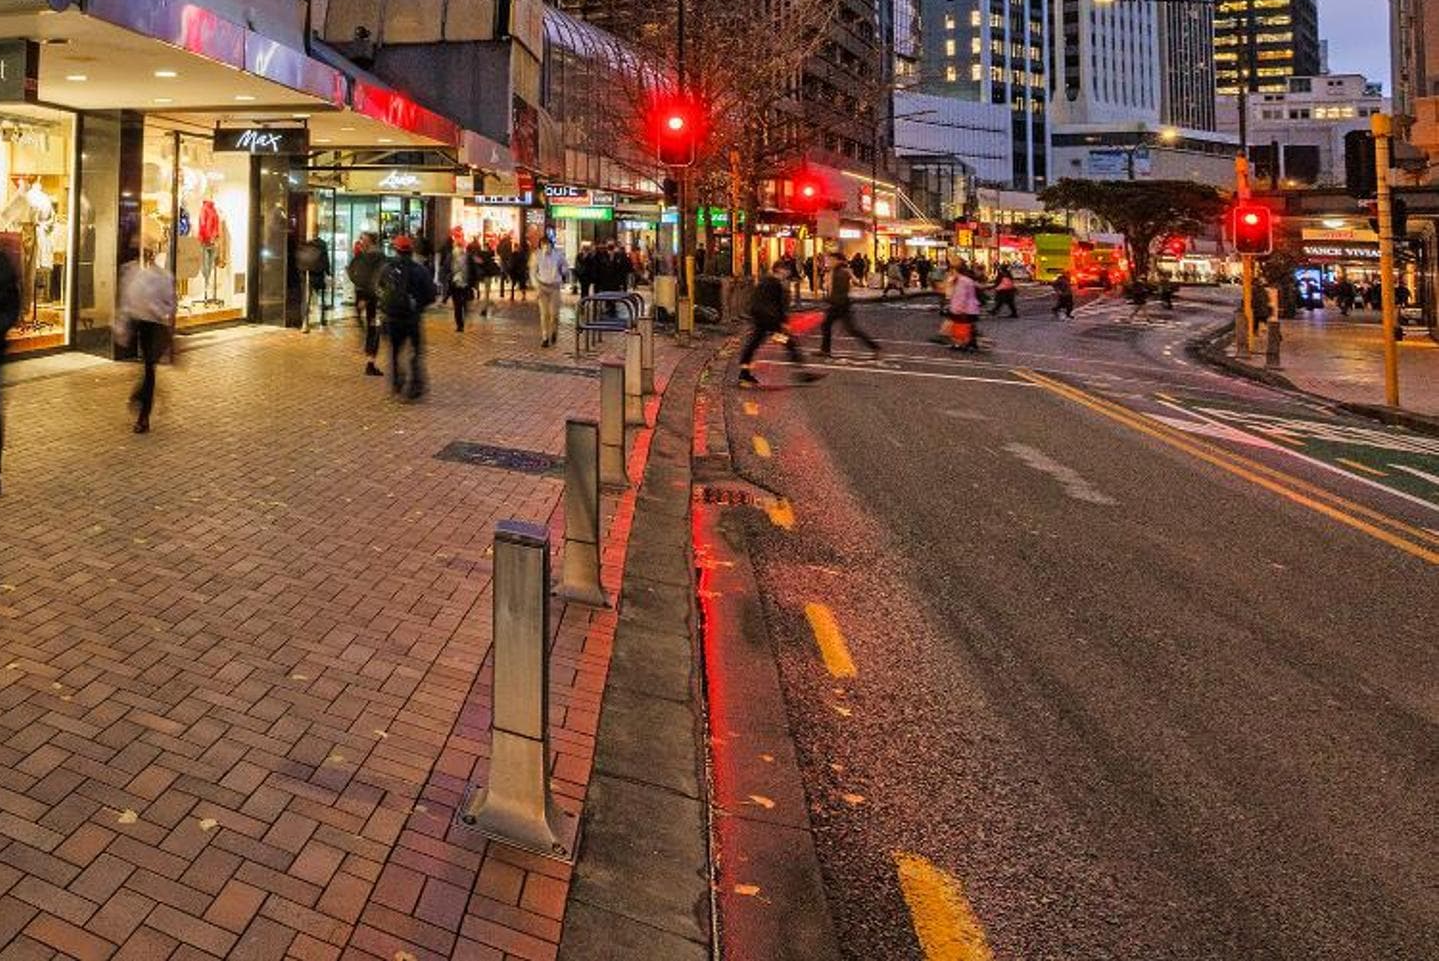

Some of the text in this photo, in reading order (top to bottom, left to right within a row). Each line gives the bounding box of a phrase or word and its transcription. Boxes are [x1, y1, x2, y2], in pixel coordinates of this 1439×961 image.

[235, 129, 282, 153] Max
[1303, 246, 1382, 258] VANCE VIVIA
